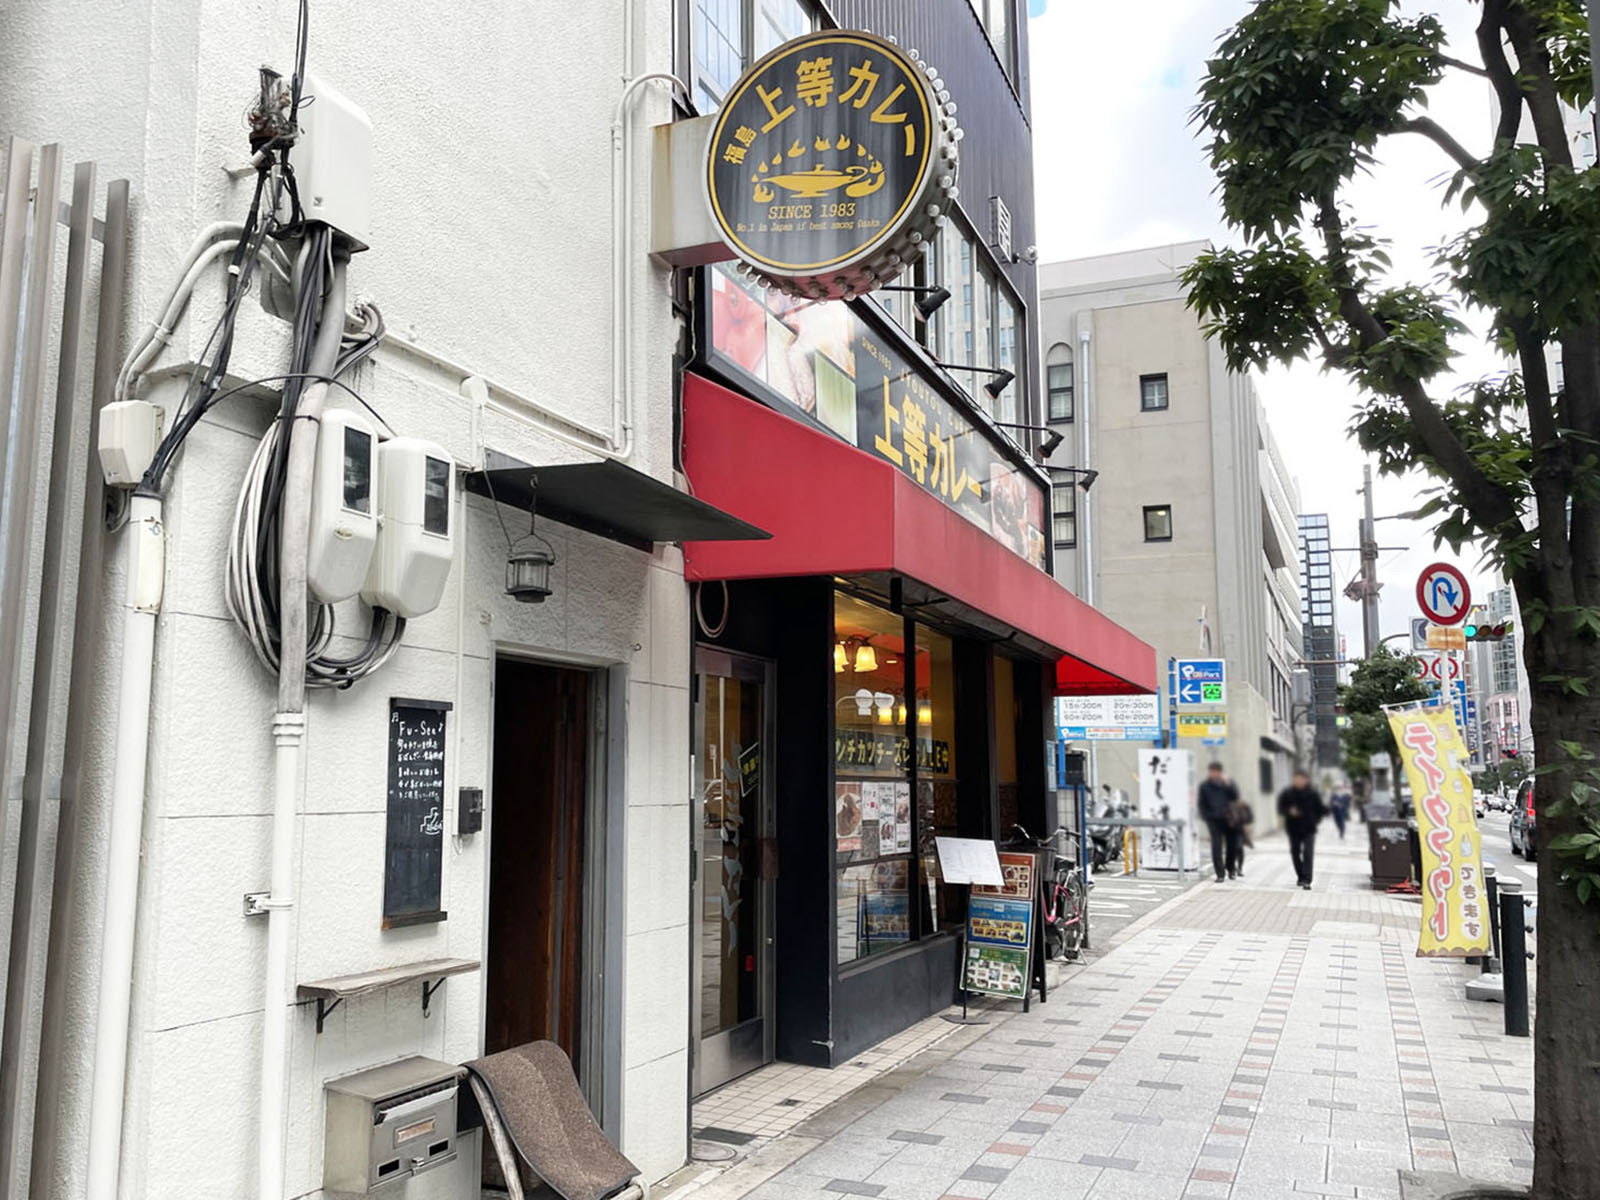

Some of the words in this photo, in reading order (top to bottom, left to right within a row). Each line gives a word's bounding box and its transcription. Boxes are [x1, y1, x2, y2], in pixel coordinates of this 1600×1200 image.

[723, 126, 757, 165] 福島
[755, 57, 915, 157] 上等カレー
[768, 205, 812, 220] SINCE
[819, 203, 856, 218] 1983
[874, 374, 982, 503] 上等カレー
